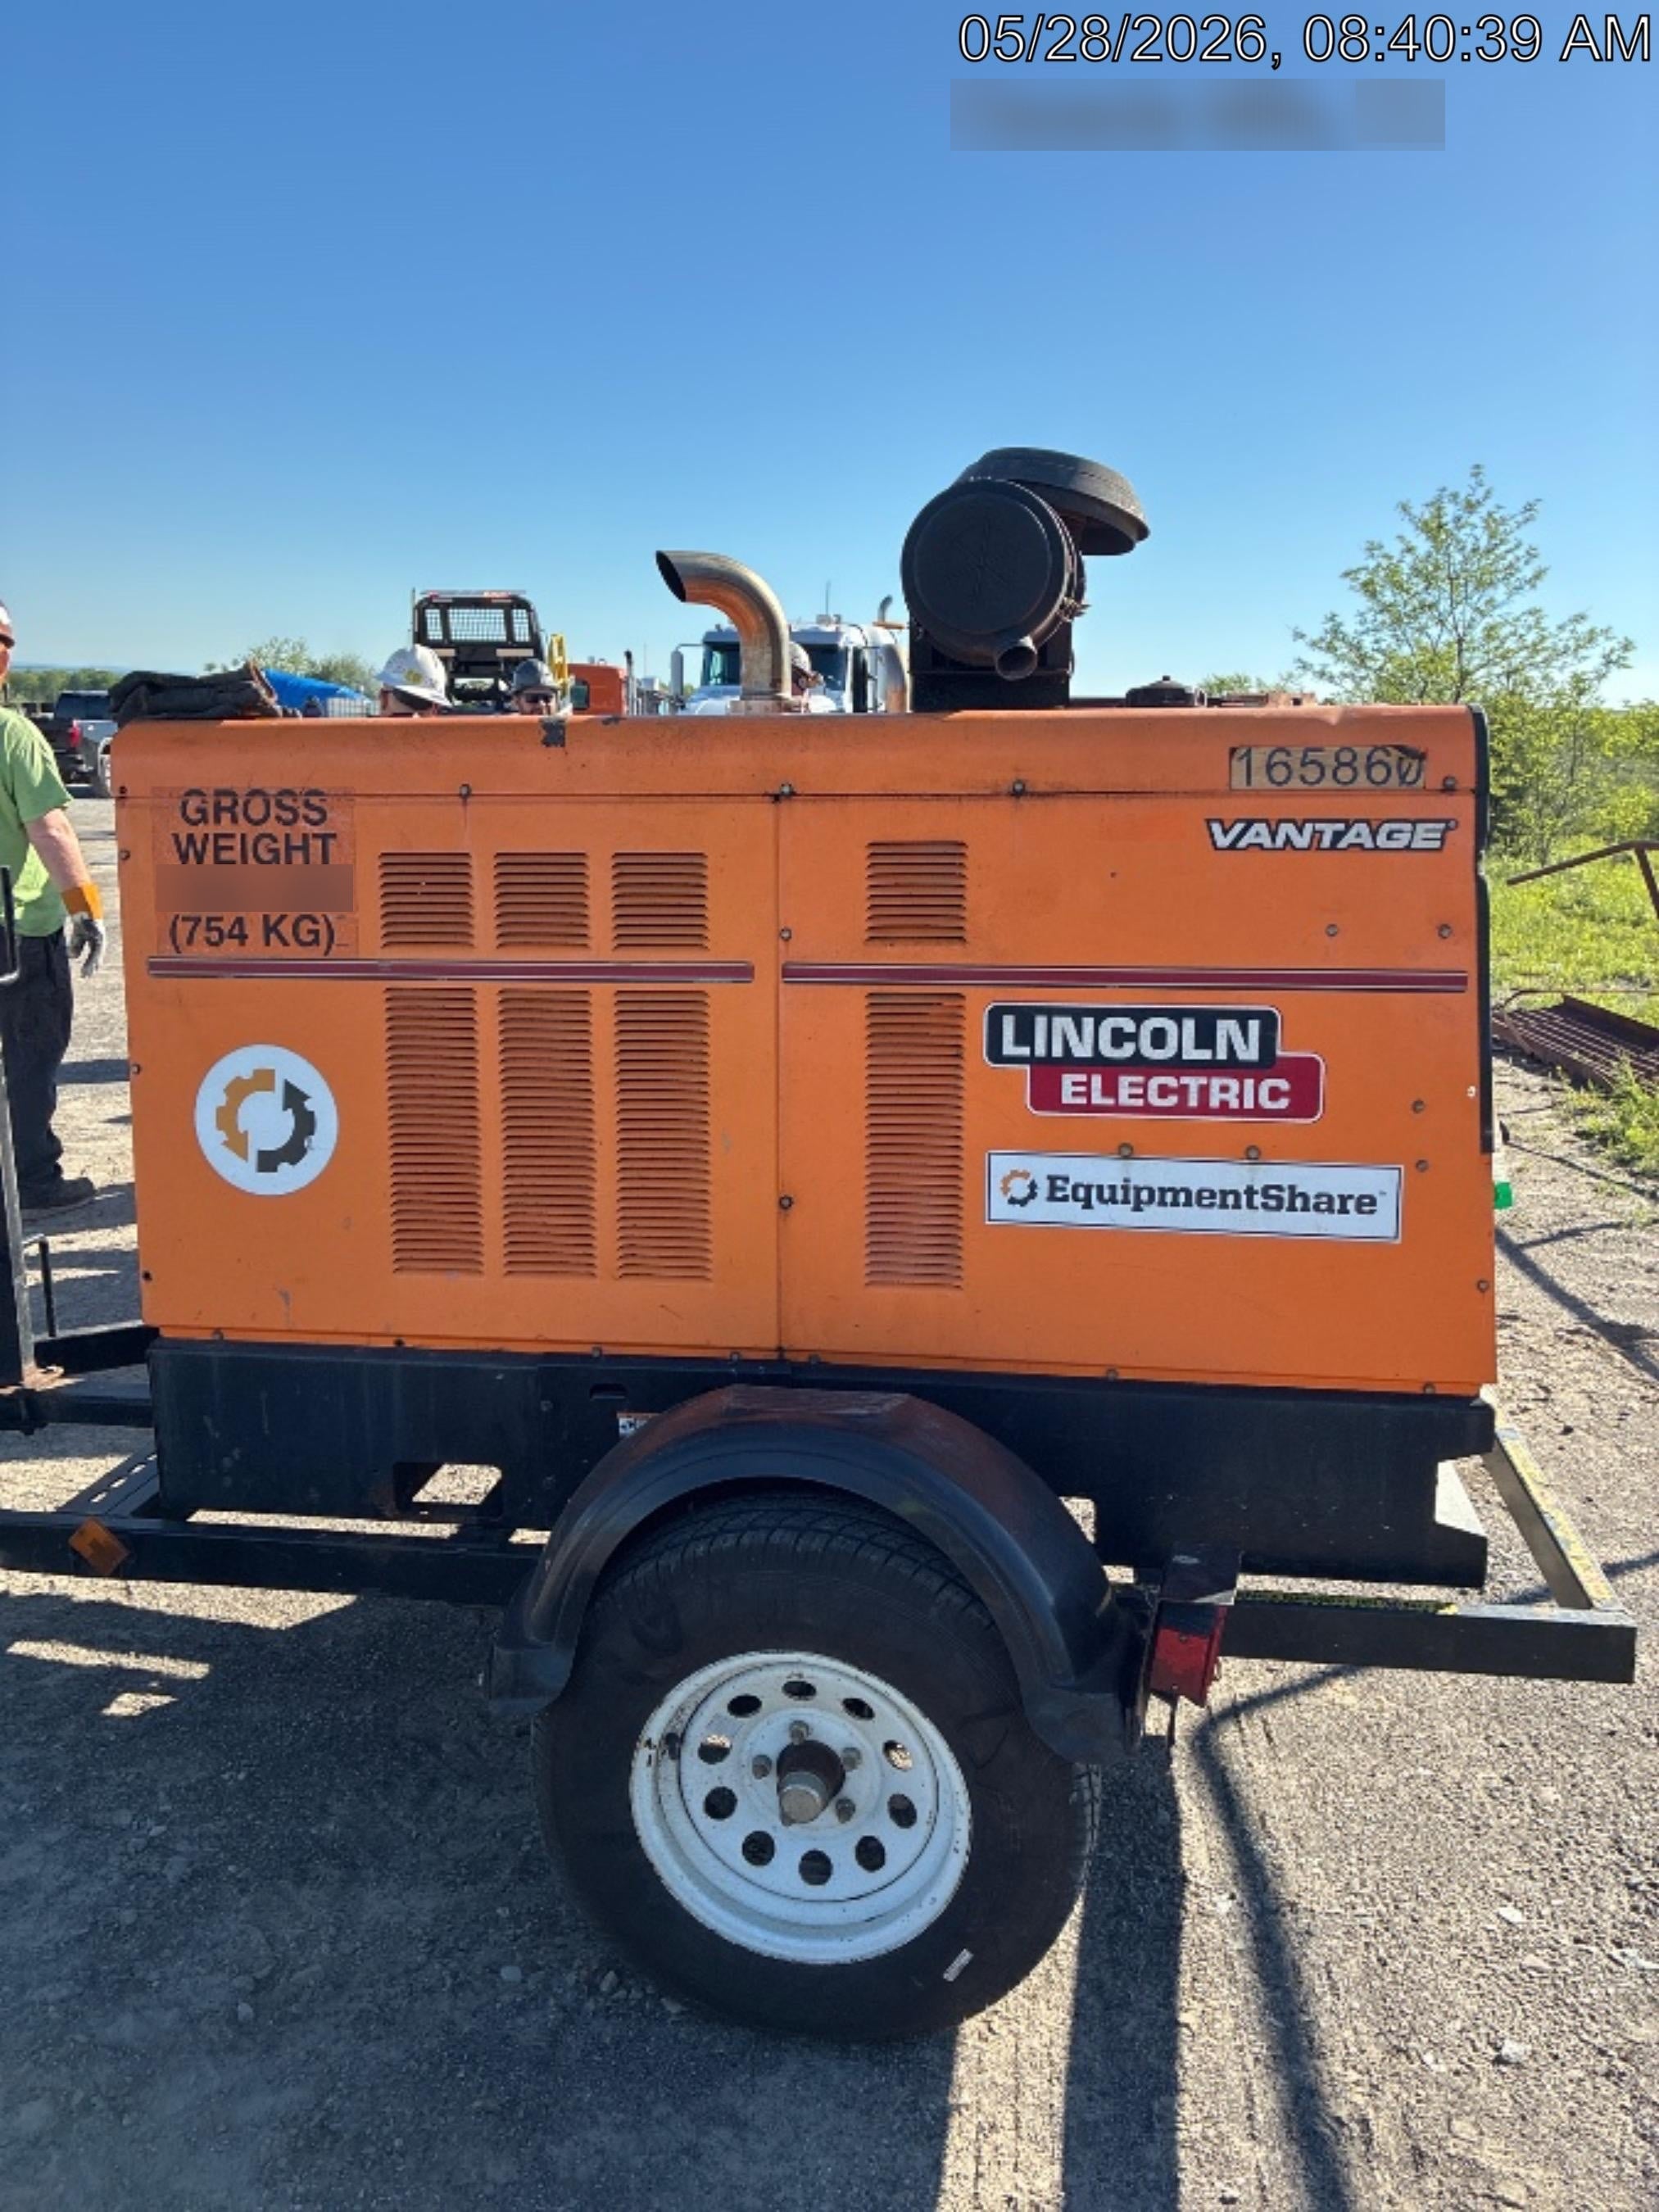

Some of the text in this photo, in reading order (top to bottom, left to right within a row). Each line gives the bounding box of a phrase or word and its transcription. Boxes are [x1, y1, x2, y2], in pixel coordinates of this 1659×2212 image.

[180, 788, 329, 827] GROSS
[171, 832, 338, 865] WEIGHT
[1208, 820, 1448, 850] VANTAGE
[170, 913, 335, 956] (754 KG)
[1001, 1014, 1262, 1062] LINCOLN
[1061, 1072, 1292, 1110] ELECTRIC
[1046, 1174, 1379, 1216] EquipmentShare
